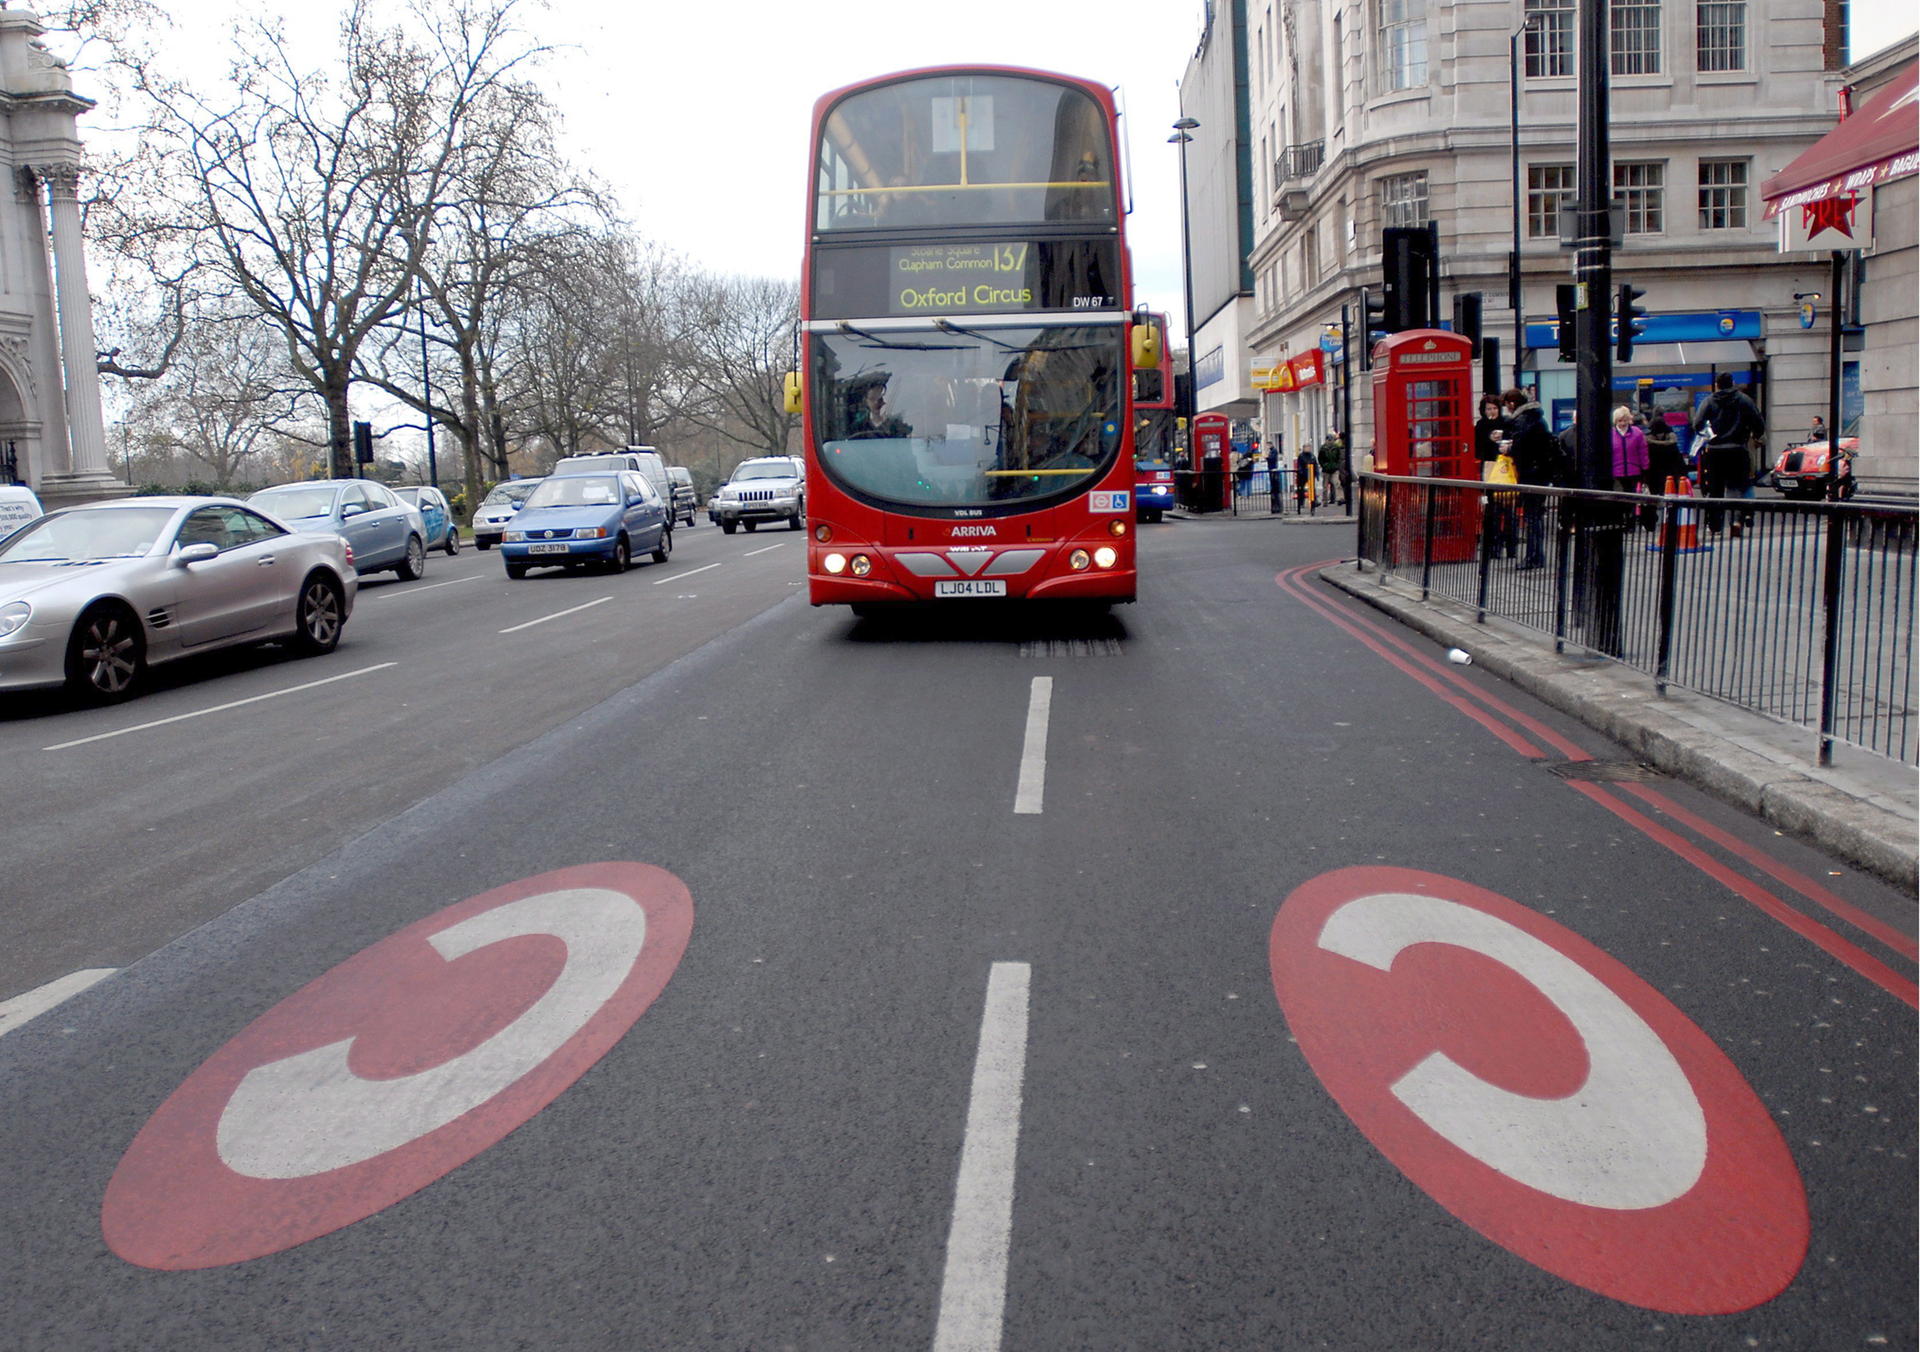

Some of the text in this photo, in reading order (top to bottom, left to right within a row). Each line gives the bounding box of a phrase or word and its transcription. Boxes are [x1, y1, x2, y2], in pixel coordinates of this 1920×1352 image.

[1779, 183, 1831, 211] SANDWICHES
[1844, 166, 1877, 190] WRAPS
[993, 242, 1029, 271] 137
[899, 257, 993, 272] Clapham Common
[900, 284, 1033, 308] Oxford Circus
[1073, 296, 1103, 307] DW 67
[951, 525, 997, 537] ARRIVA
[941, 581, 1000, 594] LJ04 LDL
